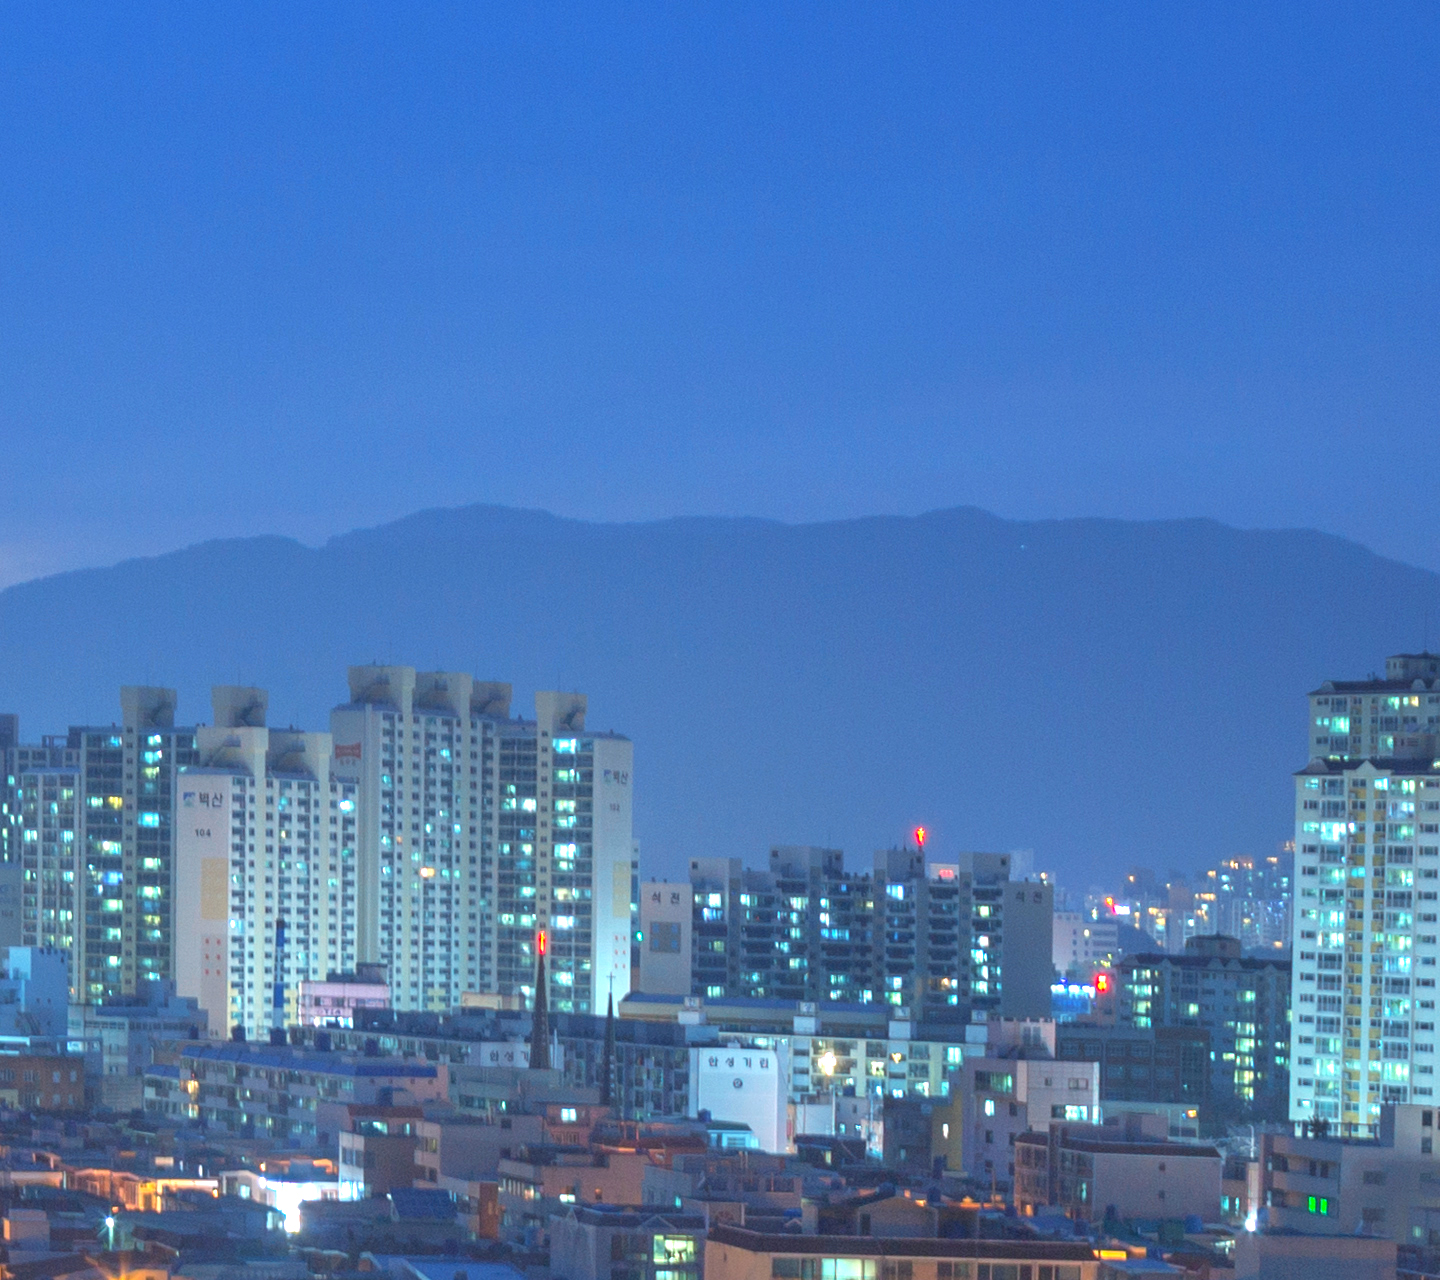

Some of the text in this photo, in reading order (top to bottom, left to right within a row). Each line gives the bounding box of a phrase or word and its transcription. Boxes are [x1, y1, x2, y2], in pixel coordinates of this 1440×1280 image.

[199, 792, 223, 808] 백산
[195, 828, 211, 837] 104
[489, 1049, 530, 1063] 한성기
[708, 1055, 770, 1070] 한성기린
